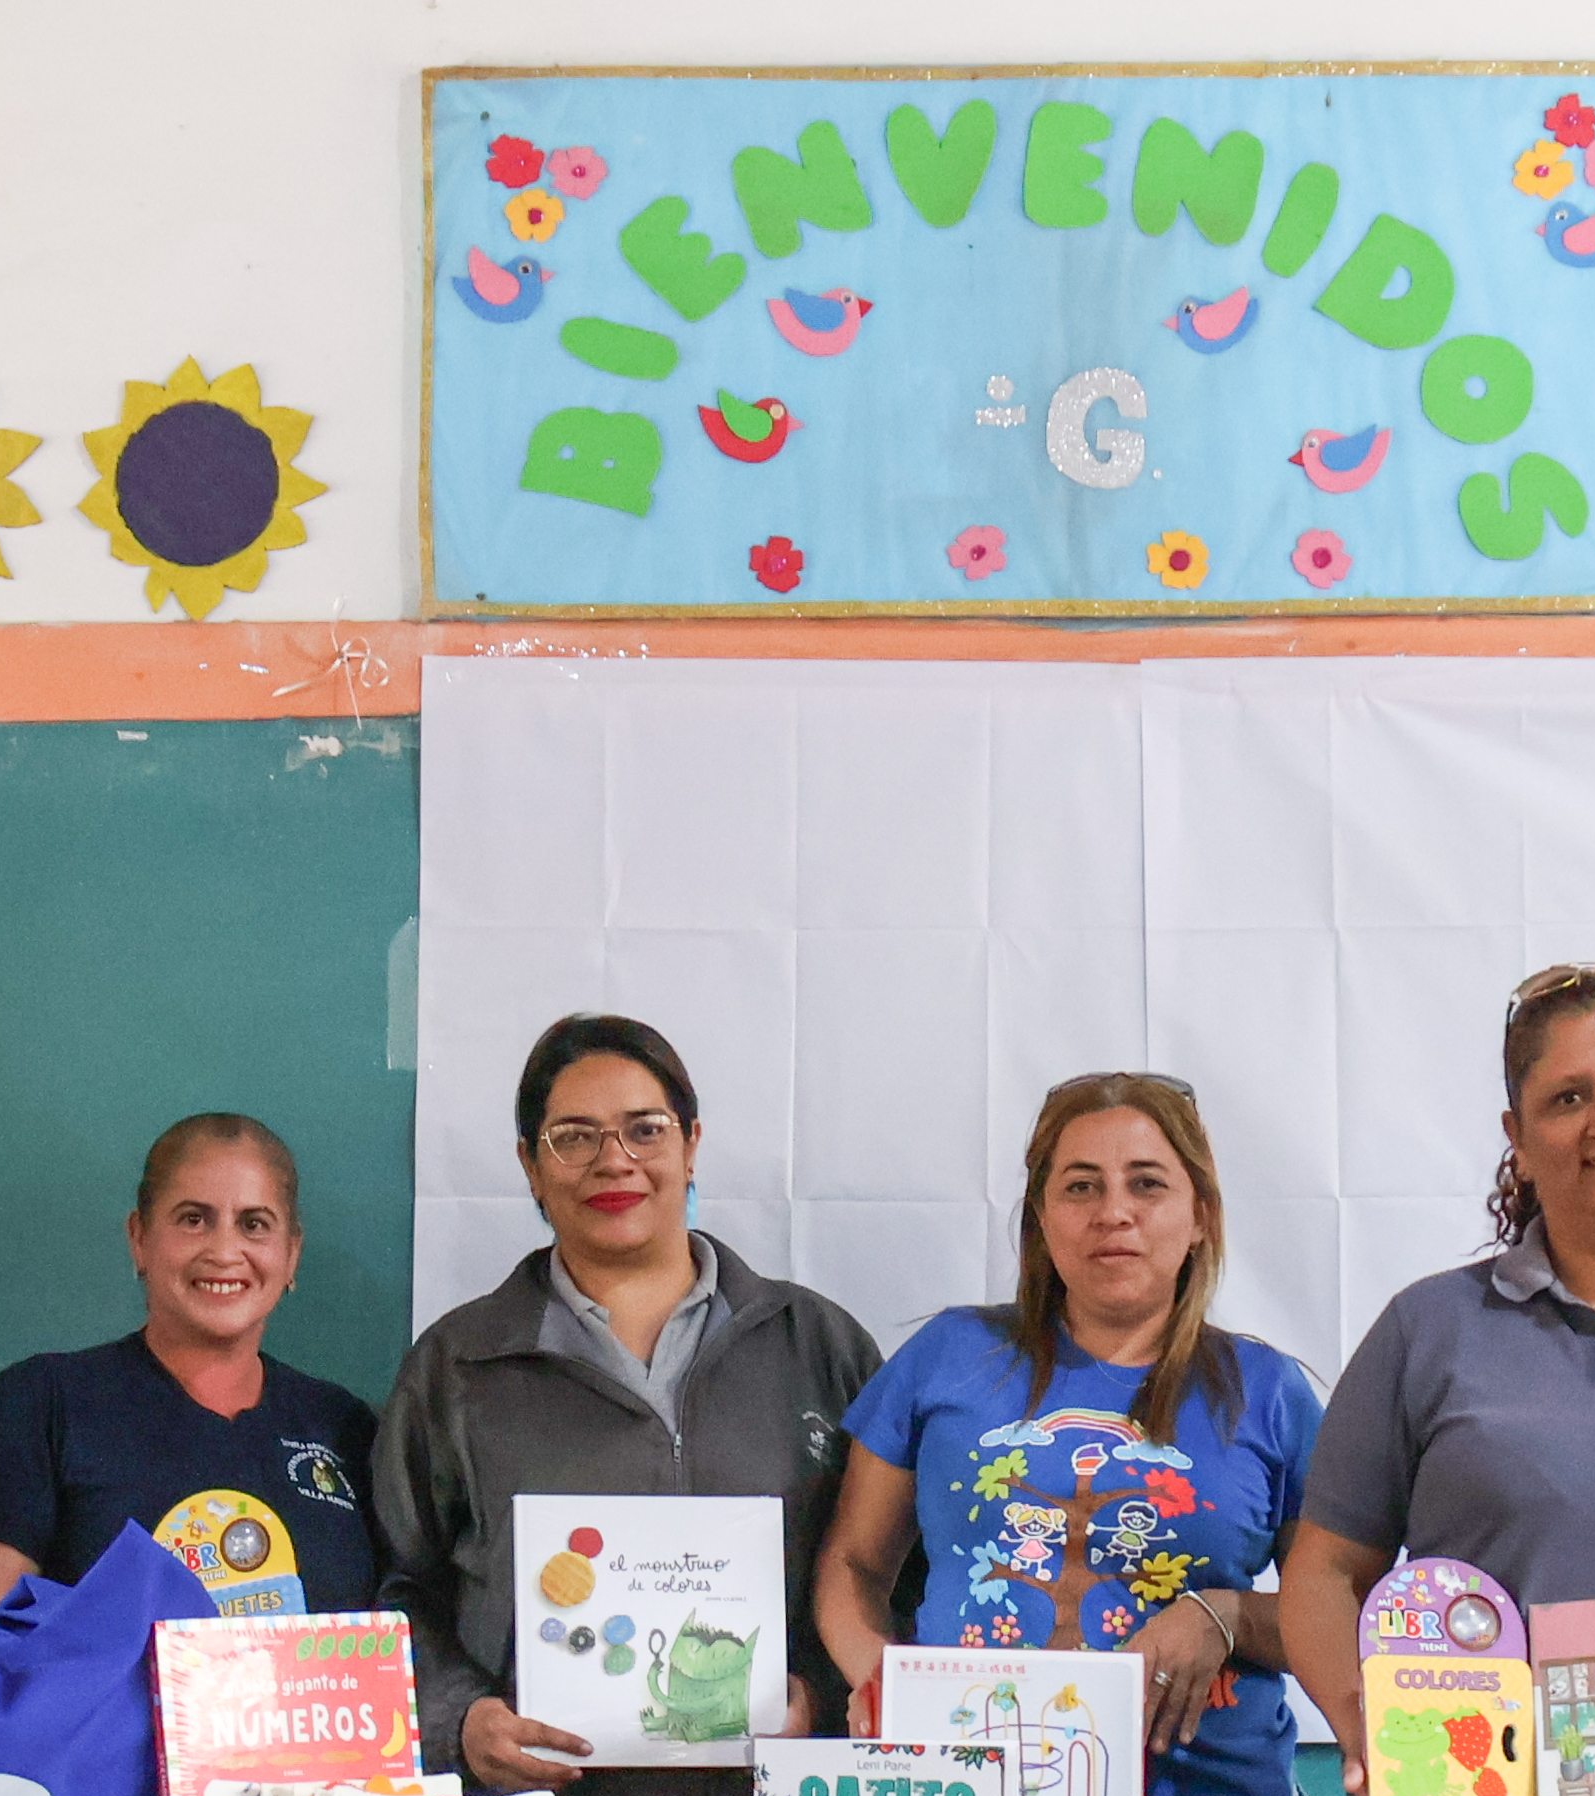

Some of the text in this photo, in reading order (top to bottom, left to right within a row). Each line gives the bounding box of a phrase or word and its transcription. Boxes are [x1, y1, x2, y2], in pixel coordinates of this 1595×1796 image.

[520, 99, 1589, 561] BIENVENIDOS
[609, 1552, 731, 1573] el monstruo
[627, 1577, 712, 1593] de colores
[218, 1590, 283, 1617] UETES
[282, 1673, 359, 1696] gigante de
[1395, 1668, 1501, 1692] COLORES
